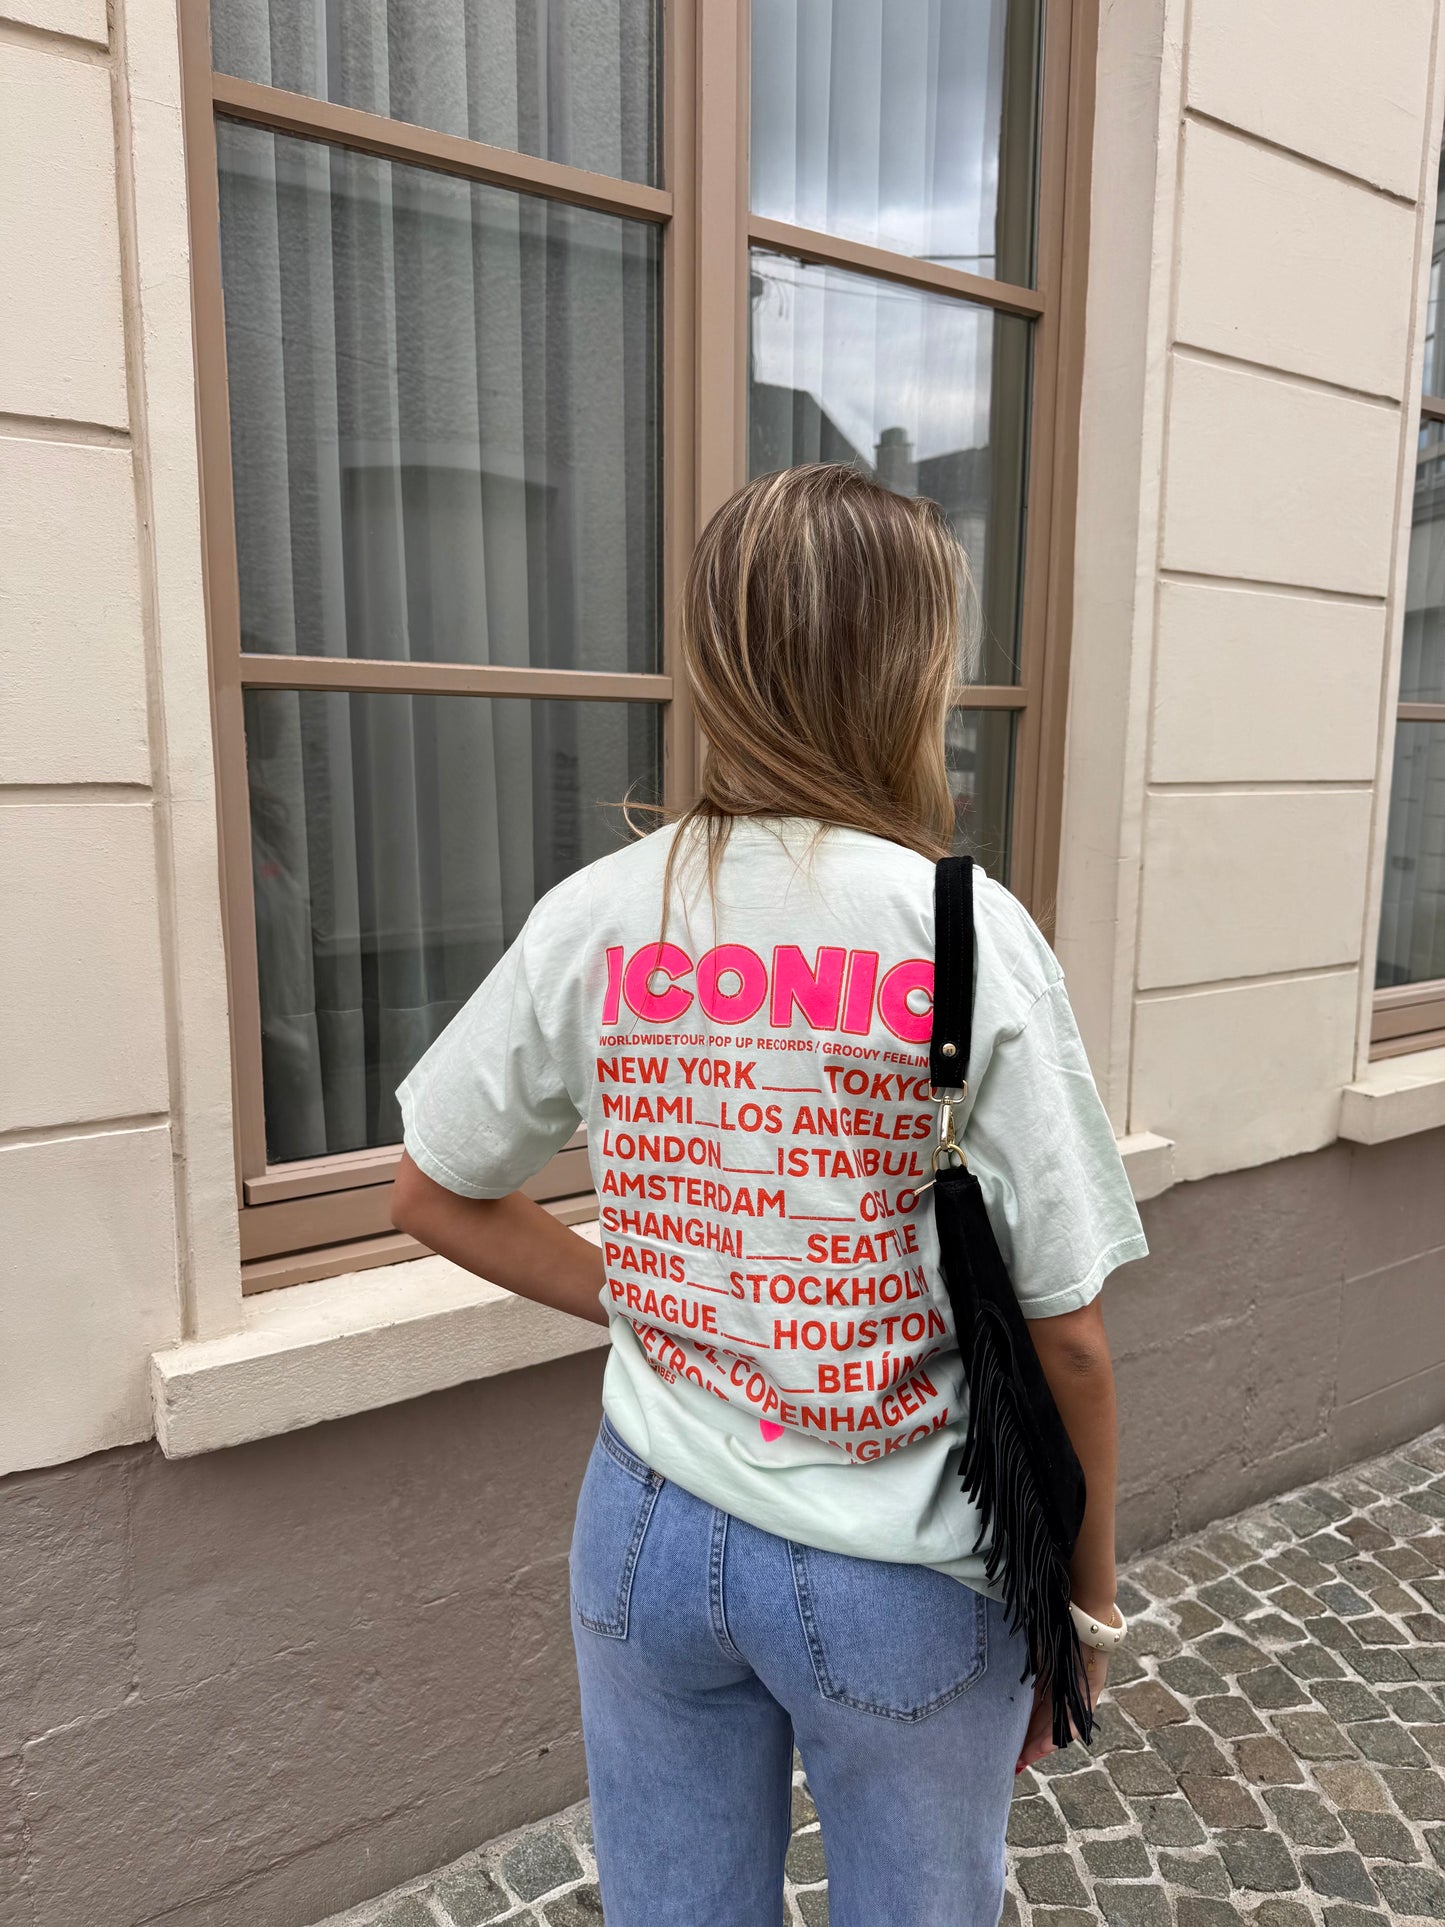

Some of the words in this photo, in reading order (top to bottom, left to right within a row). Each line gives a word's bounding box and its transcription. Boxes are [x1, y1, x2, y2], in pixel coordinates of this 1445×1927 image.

[601, 942, 934, 1044] ICONIC
[708, 1035, 731, 1048] POP
[735, 1037, 753, 1049] UP
[757, 1038, 812, 1052] RECORDS
[823, 1042, 880, 1061] GROOVY
[883, 1051, 929, 1068] FEELIN
[596, 1057, 669, 1085] NEW
[678, 1057, 757, 1090] YORK
[823, 1065, 938, 1102] TOKYO
[602, 1093, 693, 1124] MIAMI
[721, 1102, 783, 1133] LOS
[792, 1106, 934, 1141] ANGELES
[602, 1133, 721, 1170] LONDON
[778, 1147, 923, 1179] ISTANBUL
[602, 1170, 786, 1218] AMSTERDAM
[860, 1188, 920, 1222] OSLO
[602, 1207, 742, 1259] SHANGHAI
[605, 1242, 685, 1284] PARIS
[730, 1265, 929, 1306] STOCKHOLM
[609, 1278, 718, 1334] PRAGUE
[774, 1306, 946, 1351] HOUSTON
[730, 1359, 938, 1432] COPENHAGEN
